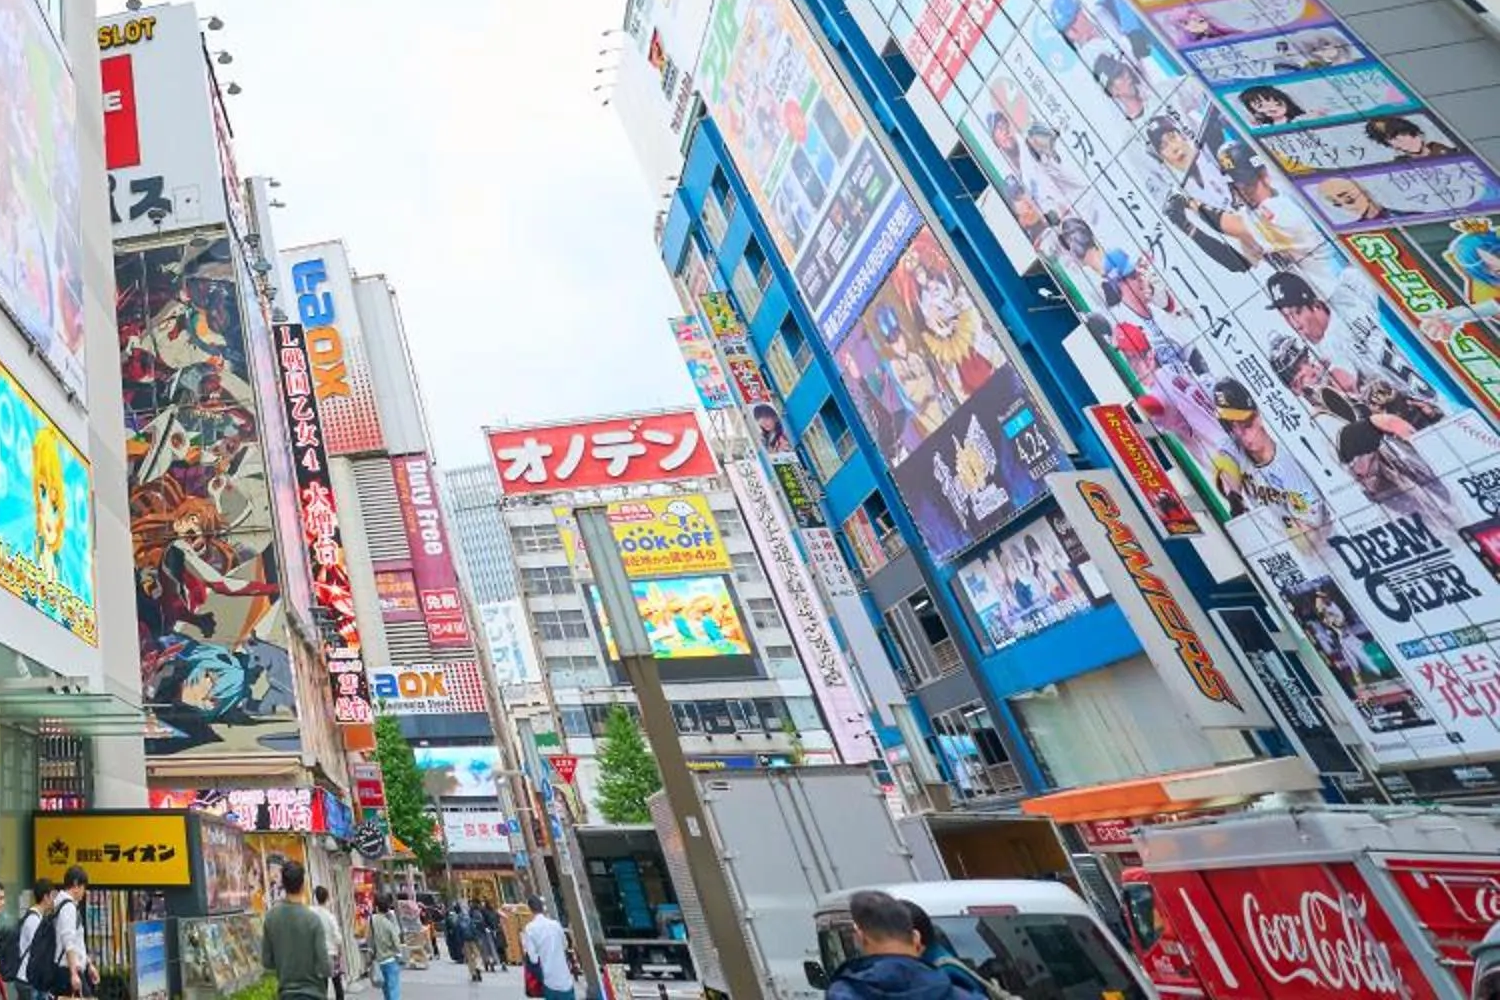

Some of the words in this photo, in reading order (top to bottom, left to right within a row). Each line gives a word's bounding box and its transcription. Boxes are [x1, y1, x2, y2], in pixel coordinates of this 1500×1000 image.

[97, 15, 157, 50] SLOT
[498, 420, 699, 485] オノデン
[1327, 511, 1444, 579] DREAM
[1360, 562, 1483, 624] ORDER
[1242, 890, 1404, 994] Coca-Cola
